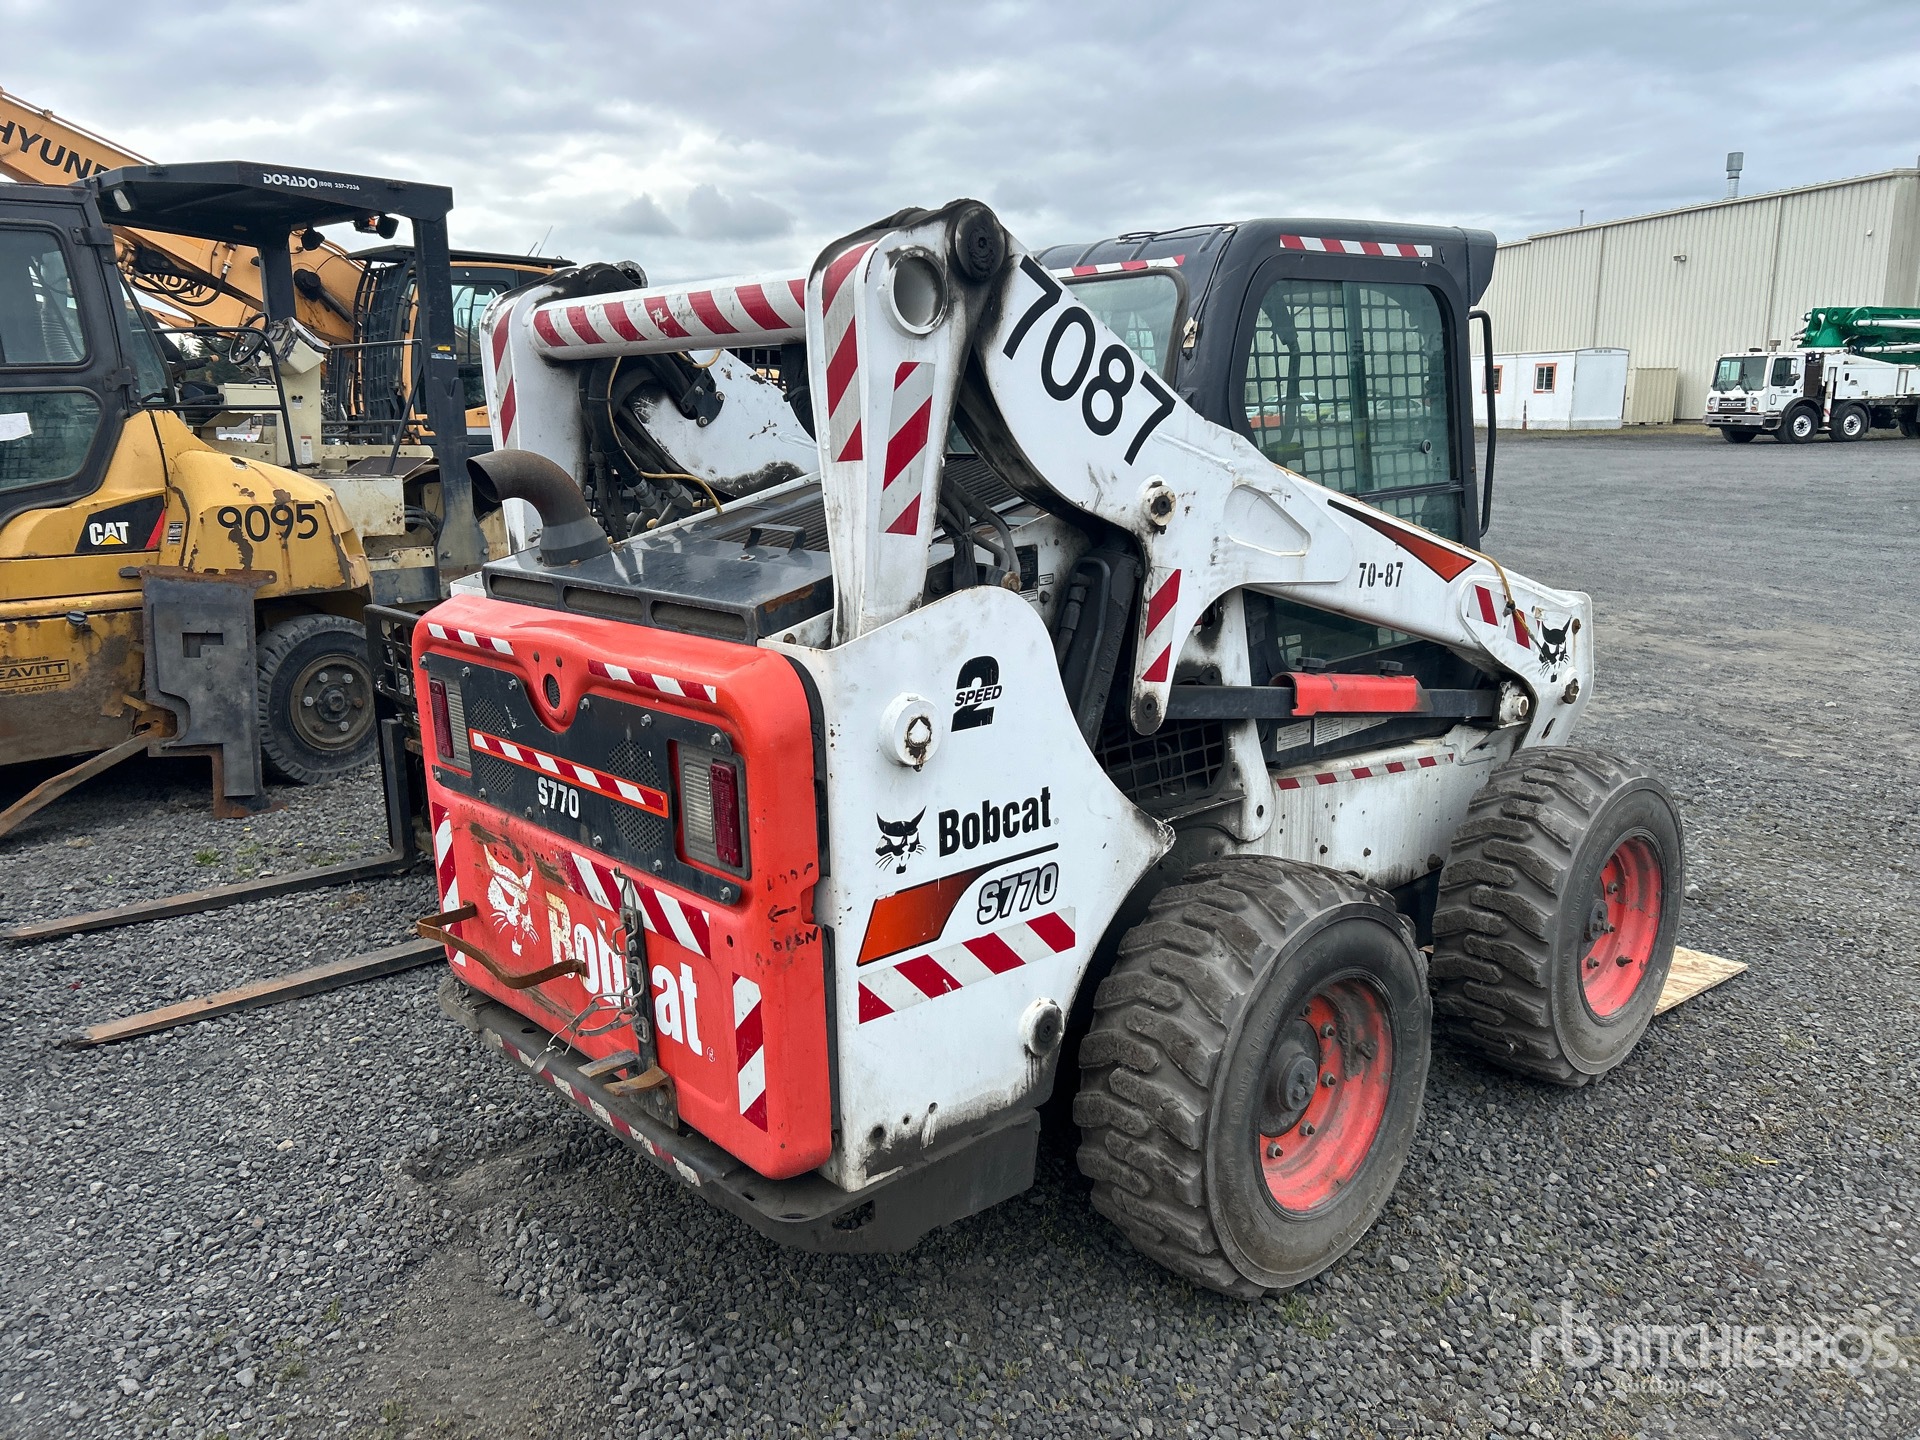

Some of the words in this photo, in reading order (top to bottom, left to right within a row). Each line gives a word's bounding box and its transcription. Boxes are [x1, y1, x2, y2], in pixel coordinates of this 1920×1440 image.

[262, 173, 318, 189] DORADO
[1002, 254, 1176, 466] 7087
[88, 521, 129, 546] CAT
[217, 503, 319, 542] 9095
[1359, 561, 1403, 588] 70-87
[954, 685, 1003, 707] SPEED
[537, 776, 580, 819] S770
[938, 786, 1051, 857] Bobcat
[976, 861, 1059, 926] S770
[546, 891, 703, 1056] Bobat
